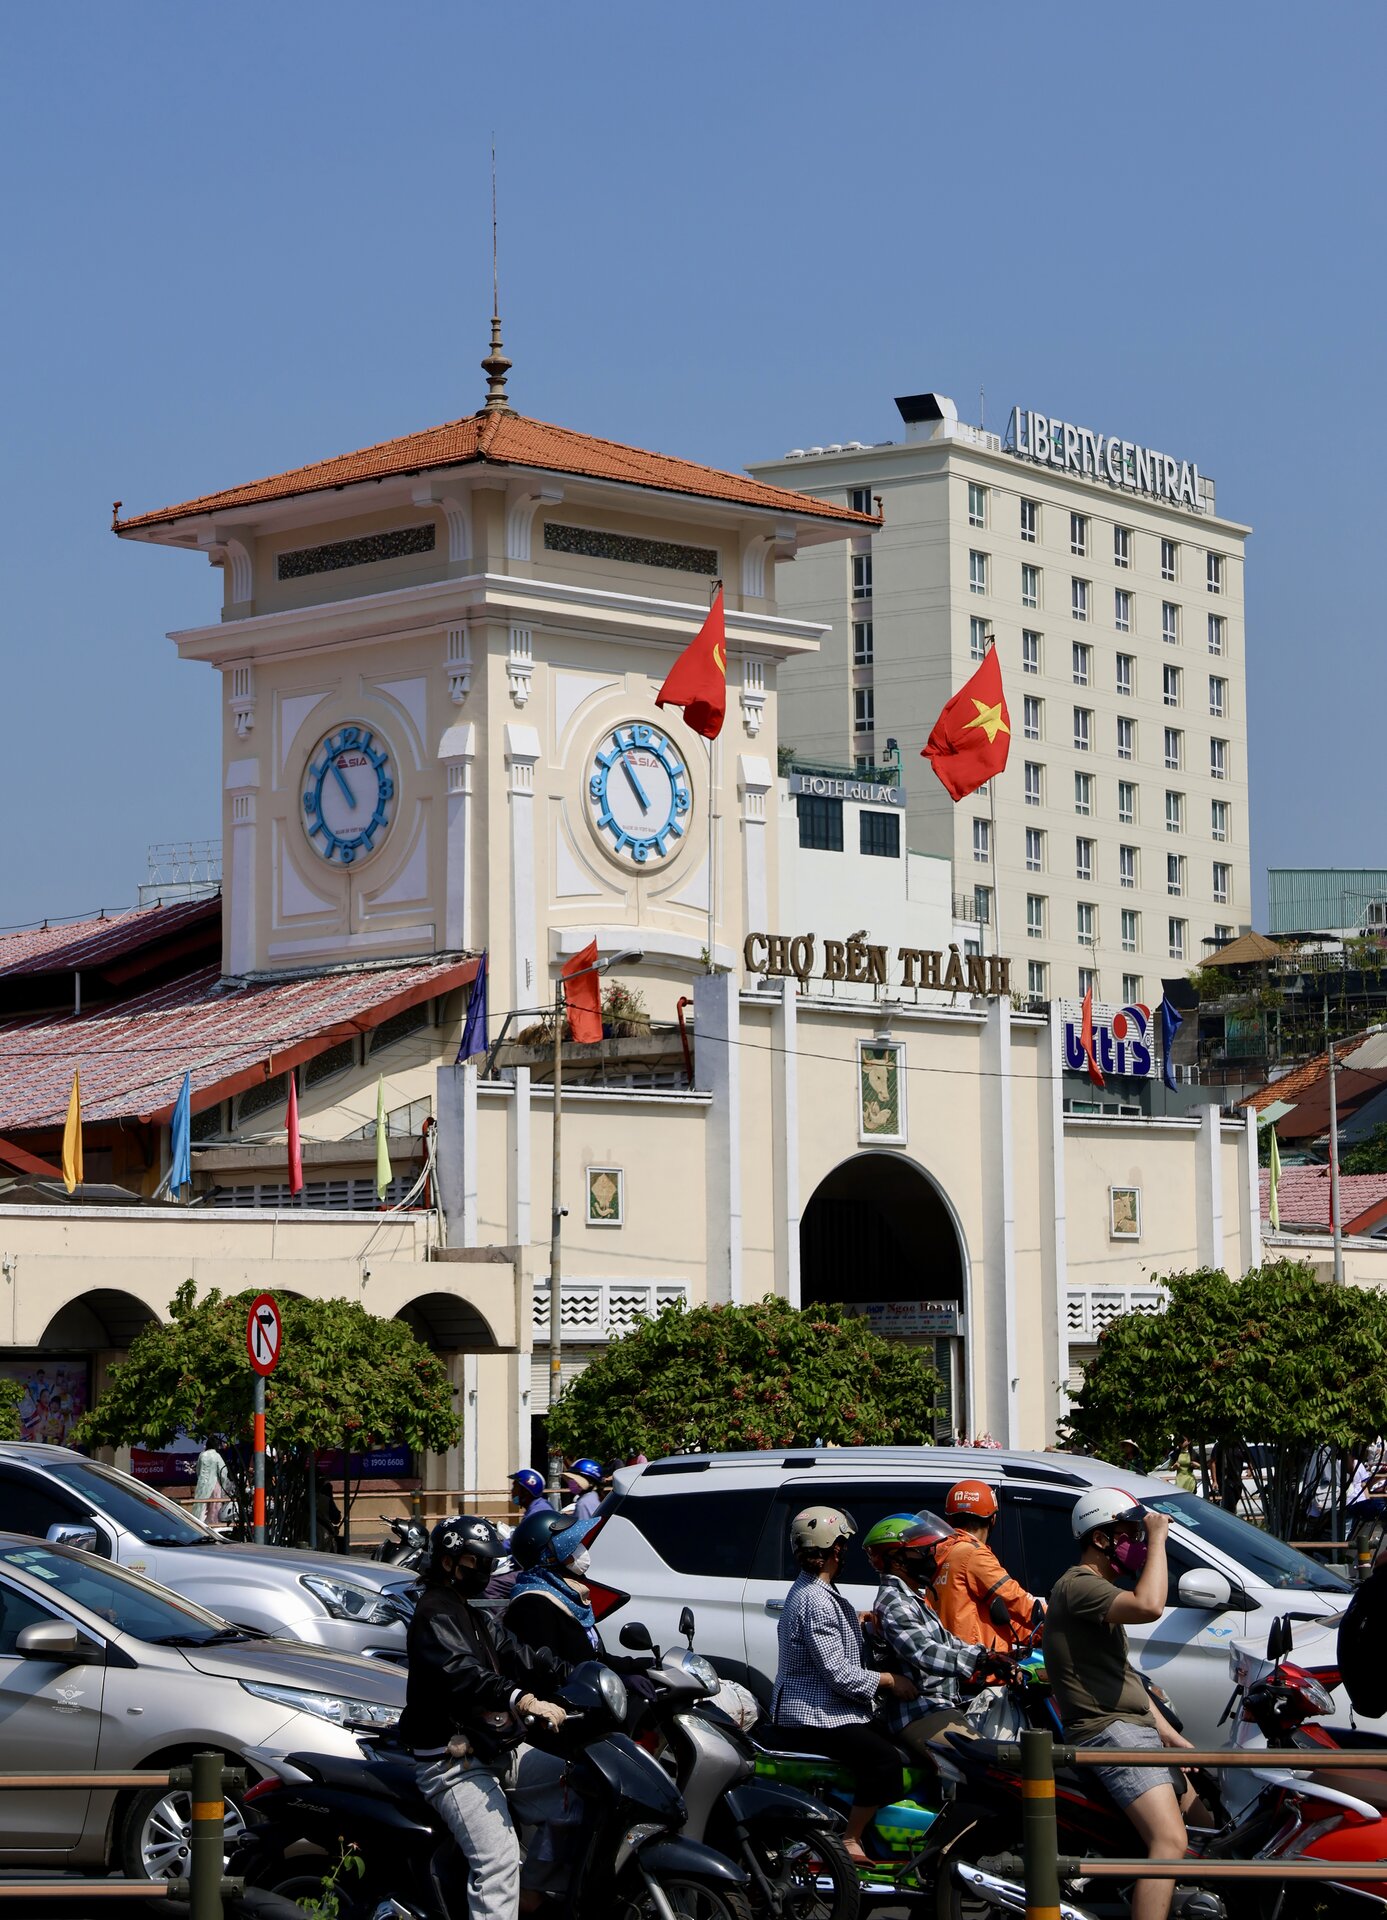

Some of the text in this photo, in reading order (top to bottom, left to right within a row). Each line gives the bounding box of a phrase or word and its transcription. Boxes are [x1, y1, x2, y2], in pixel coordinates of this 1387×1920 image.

[1013, 406, 1206, 508] LIBERTY CENTRAL
[338, 727, 361, 750] 12
[632, 725, 653, 747] 12
[378, 778, 394, 800] 3
[676, 788, 690, 810] 3
[800, 777, 897, 803] HOTEL du LAC
[340, 842, 354, 863] 6
[633, 841, 649, 862] 6
[743, 930, 1011, 996] CHỢ BẾN THÀNH
